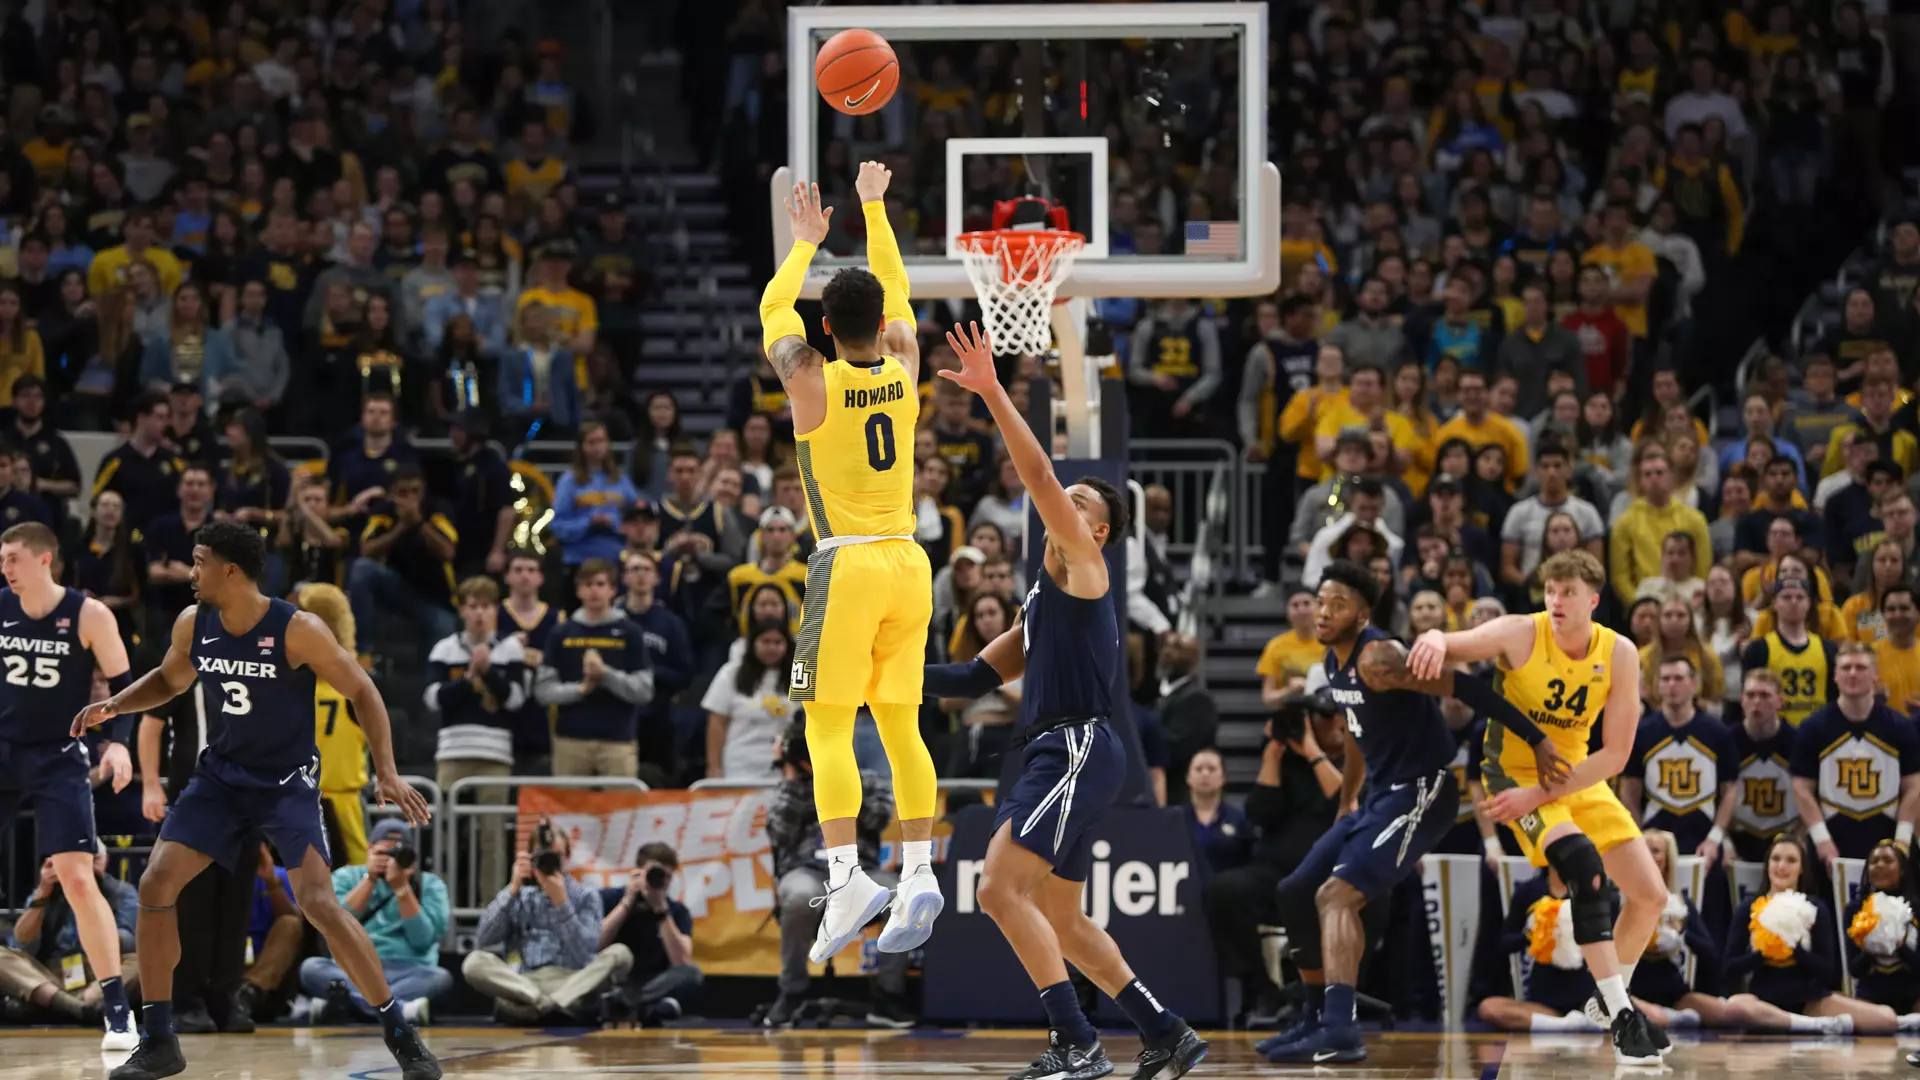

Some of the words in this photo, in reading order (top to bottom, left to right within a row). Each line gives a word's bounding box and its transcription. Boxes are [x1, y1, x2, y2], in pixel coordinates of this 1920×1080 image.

[844, 381, 904, 408] HOWARD
[865, 412, 896, 472] 0
[0, 635, 70, 655] XAVIER
[3, 655, 60, 688] 25
[198, 656, 277, 678] XAVIER
[1782, 668, 1816, 696] 33
[221, 681, 252, 715] 3
[1544, 679, 1588, 716] 34
[1345, 707, 1363, 738] 4
[1657, 758, 1701, 798] MU
[1836, 757, 1882, 799] MU
[1742, 777, 1787, 817] MU
[546, 788, 771, 871] DIREC
